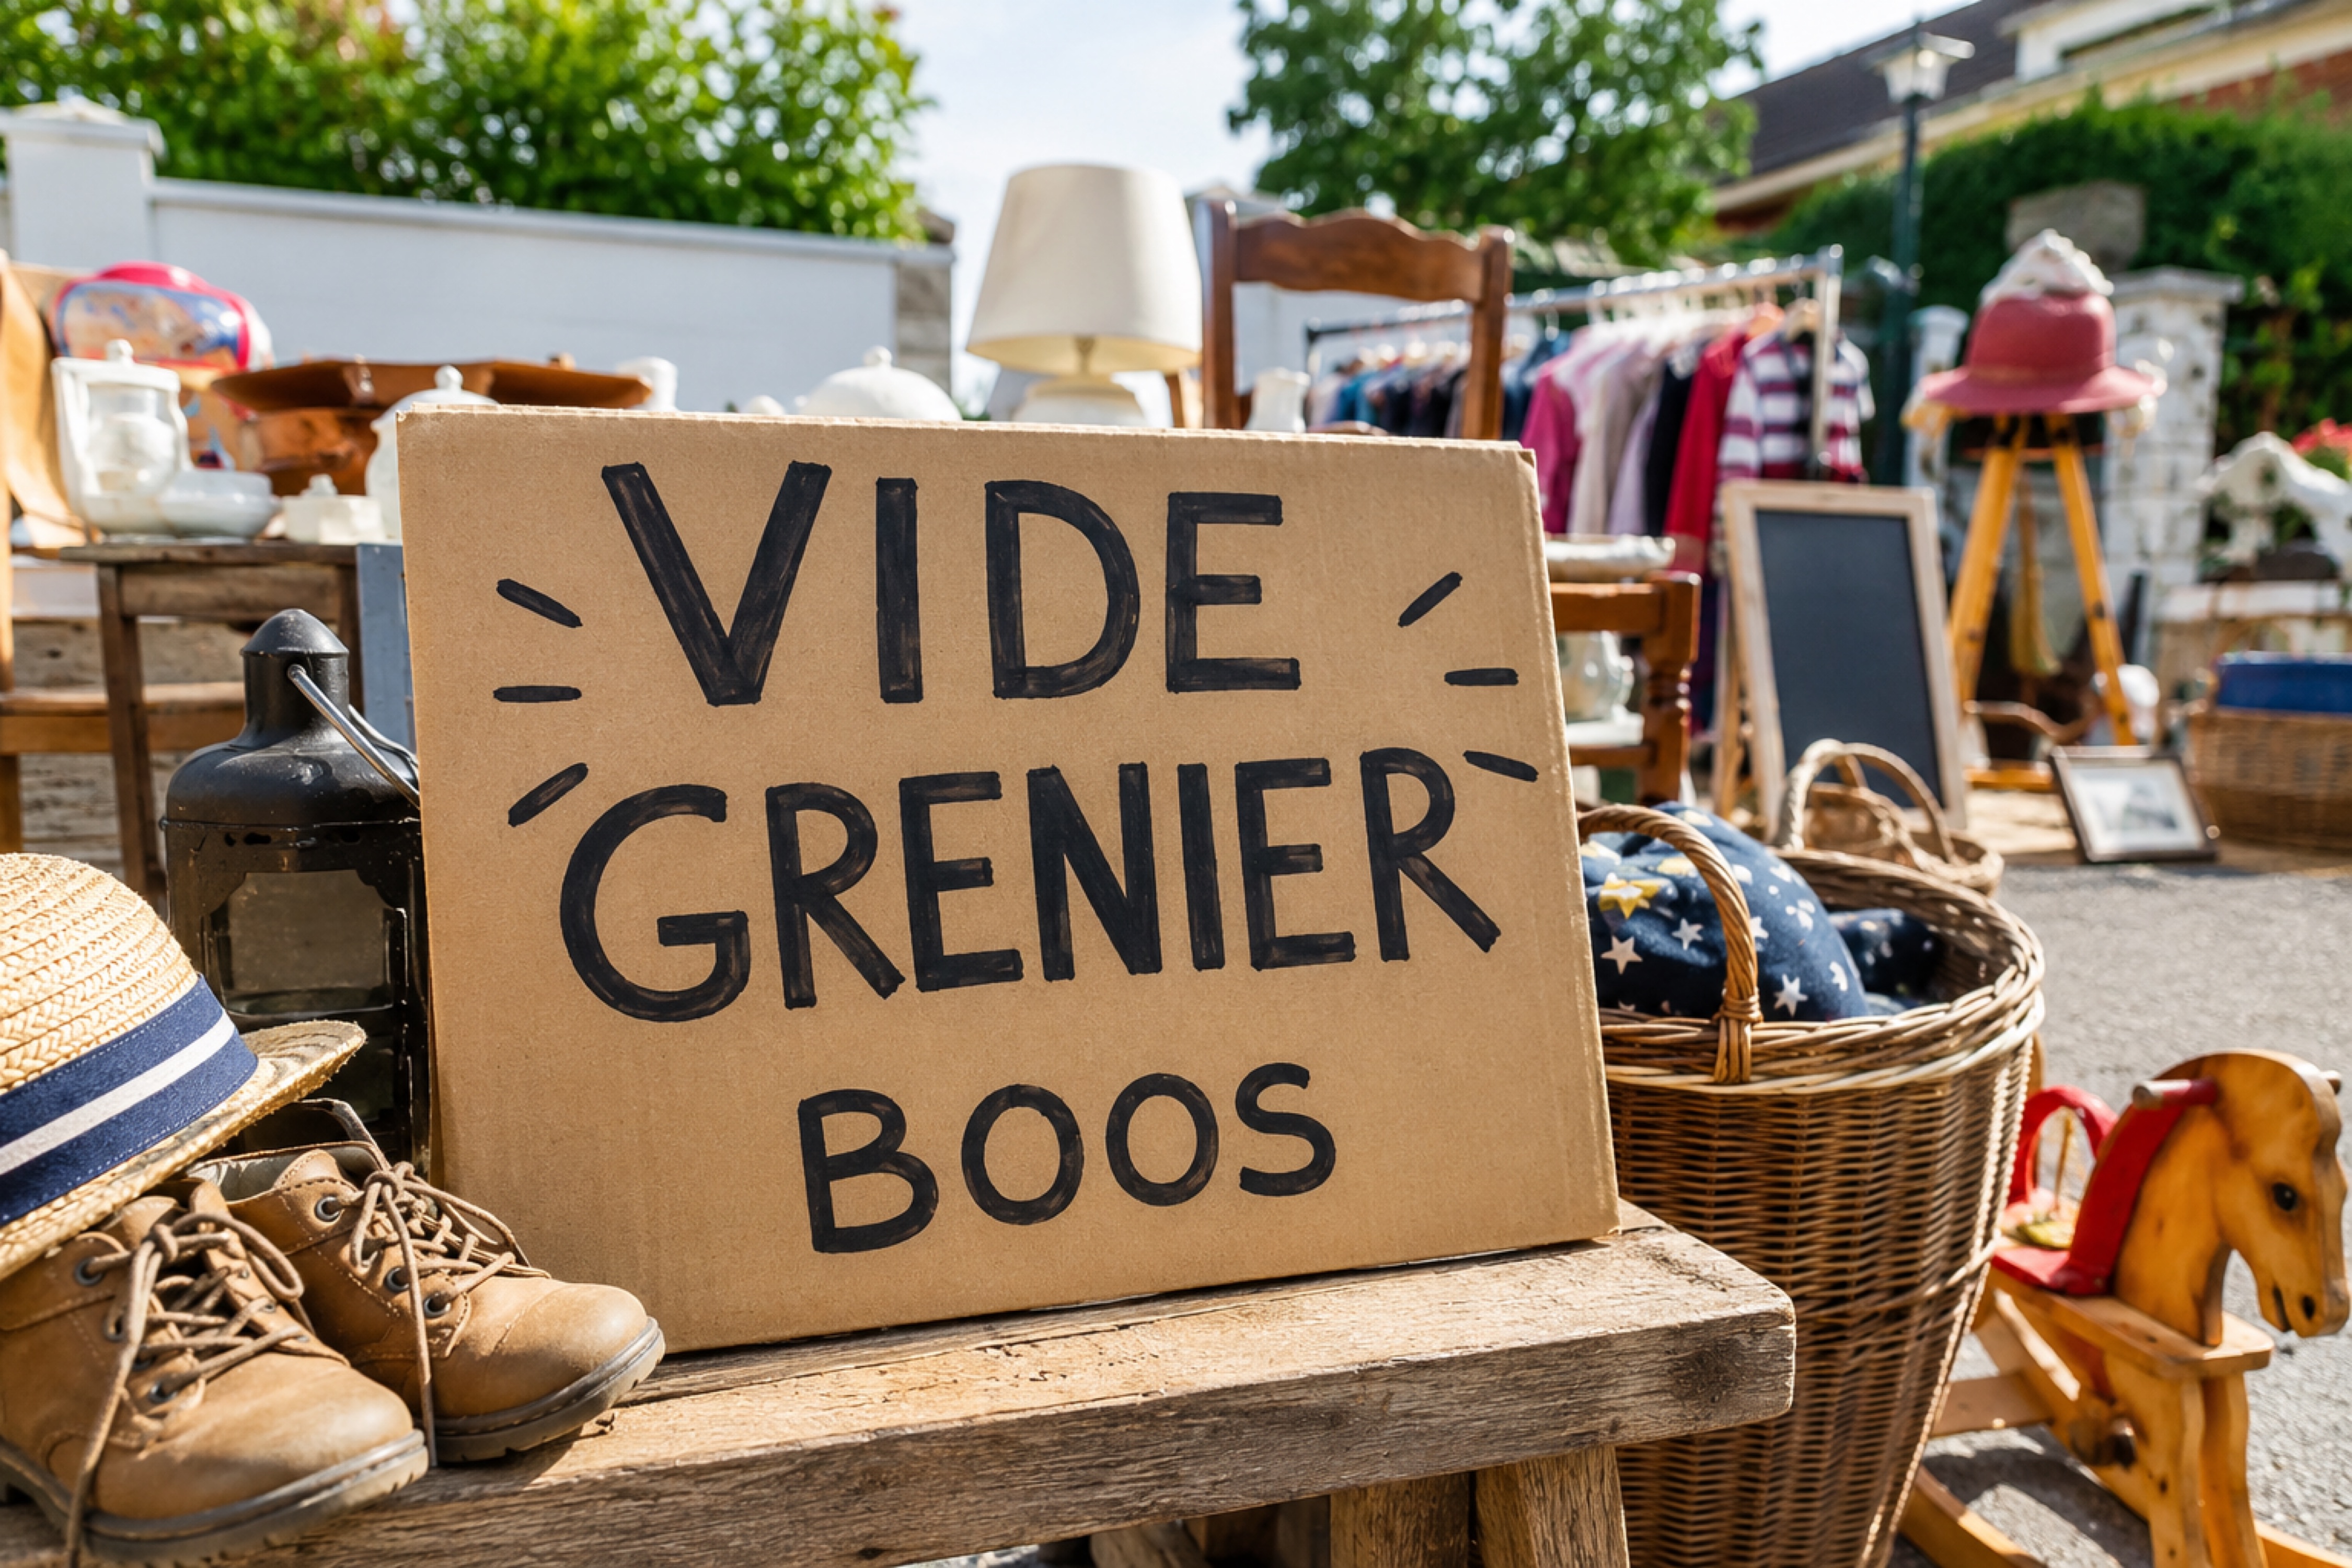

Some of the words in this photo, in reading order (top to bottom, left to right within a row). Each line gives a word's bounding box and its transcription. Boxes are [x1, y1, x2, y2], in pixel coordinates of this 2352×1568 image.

[602, 460, 1302, 708] VIDE
[560, 747, 1501, 1023] GRENIER
[798, 1063, 1336, 1254] BOOS
